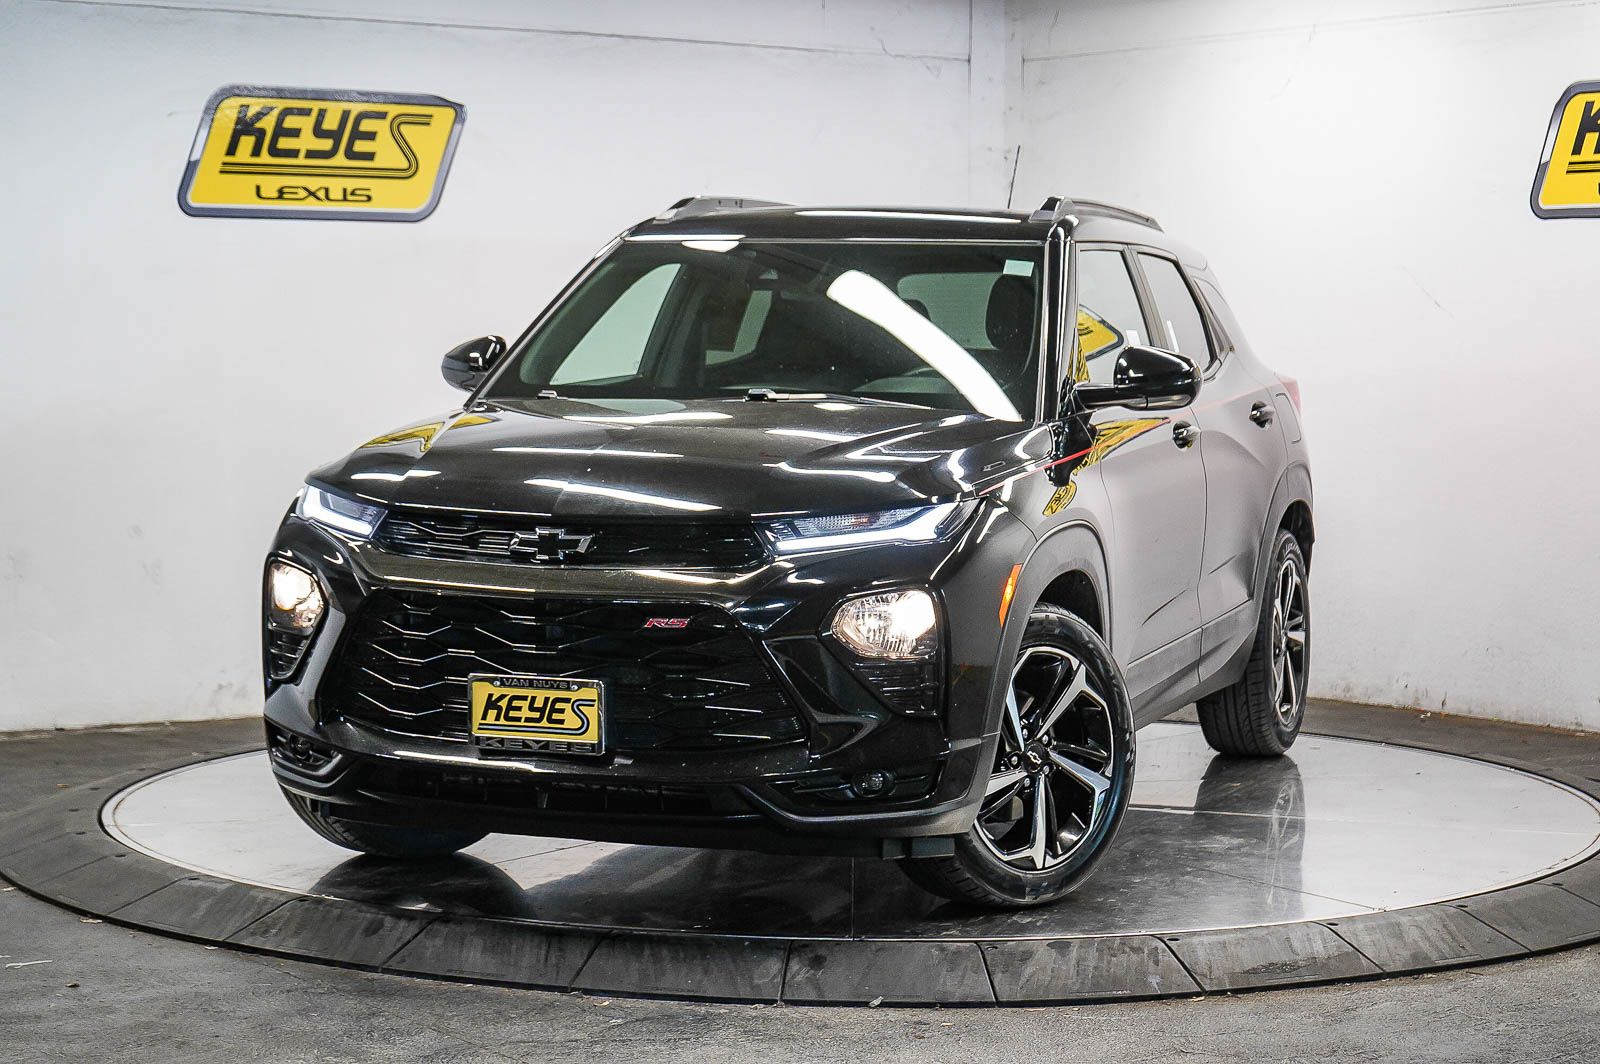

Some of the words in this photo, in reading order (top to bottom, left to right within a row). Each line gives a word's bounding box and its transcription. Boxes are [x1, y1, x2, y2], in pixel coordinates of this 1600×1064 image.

[220, 104, 433, 179] KEYES
[255, 184, 372, 203] LEXUS
[644, 617, 690, 628] RS
[504, 678, 529, 687] VAN
[533, 679, 568, 688] NUYS
[478, 693, 596, 734] KEYES
[480, 738, 593, 751] KEYES
